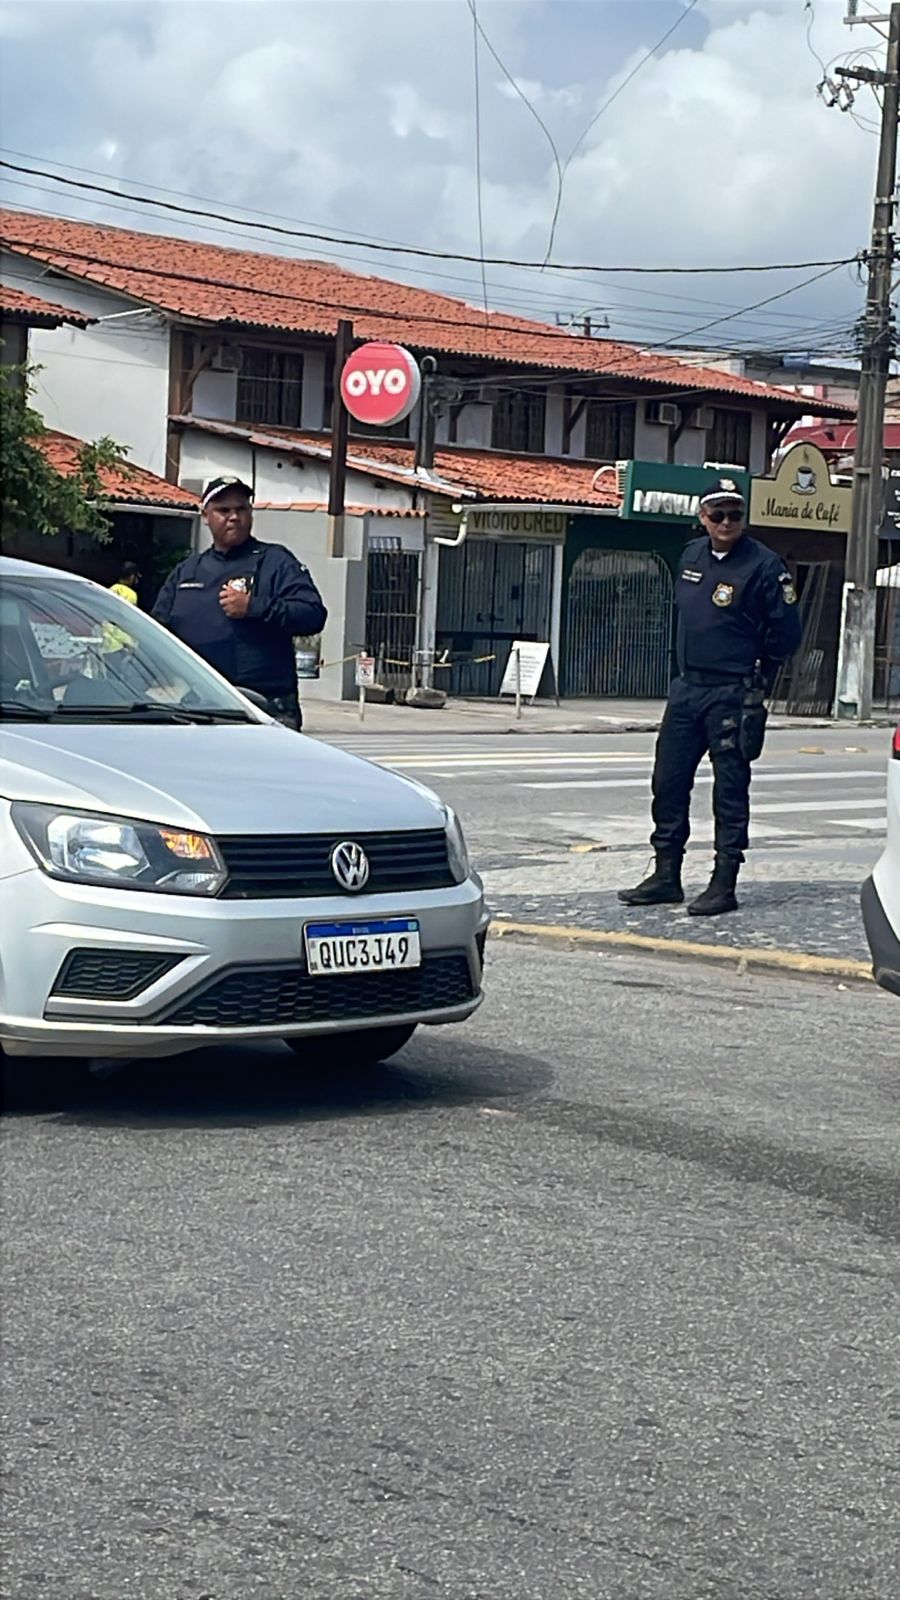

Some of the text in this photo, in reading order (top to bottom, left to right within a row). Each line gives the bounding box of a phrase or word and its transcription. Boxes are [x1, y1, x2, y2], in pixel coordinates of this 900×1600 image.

[345, 368, 406, 397] OYO
[761, 498, 840, 527] Mania de Café
[319, 937, 409, 969] QUC3J49
